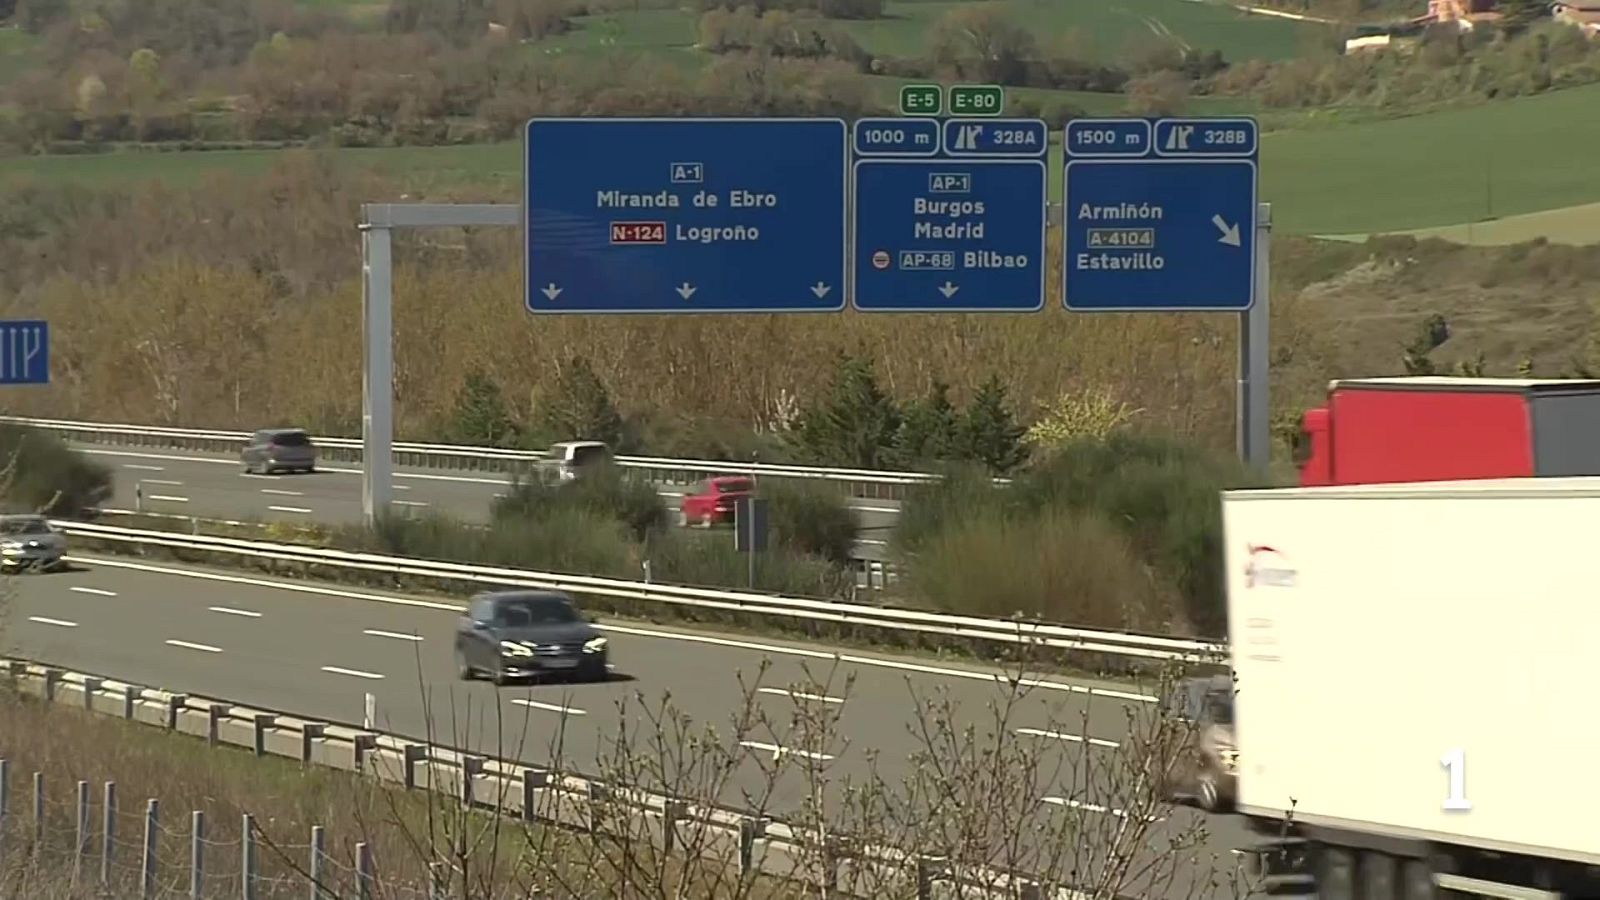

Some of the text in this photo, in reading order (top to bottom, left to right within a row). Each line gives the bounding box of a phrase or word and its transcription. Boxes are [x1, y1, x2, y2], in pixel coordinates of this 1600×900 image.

[907, 94, 934, 107] E-5
[955, 94, 995, 108] E-80
[865, 129, 930, 144] 1000 m
[993, 130, 1036, 144] 328A
[1077, 130, 1140, 144] 1500 m
[1204, 130, 1246, 144] 328B
[674, 166, 700, 179] A-1
[932, 176, 968, 190] AP-1
[596, 190, 777, 207] Miranda de Ebro
[914, 198, 985, 218] Burgos
[1078, 202, 1162, 220] Armiñón
[612, 224, 759, 244] N-124 Logroño
[914, 222, 984, 239] Madrid
[1090, 231, 1151, 246] A-4104
[903, 254, 952, 267] AP-68
[964, 251, 1027, 268] Bilbao
[1077, 253, 1164, 270] Estavillo
